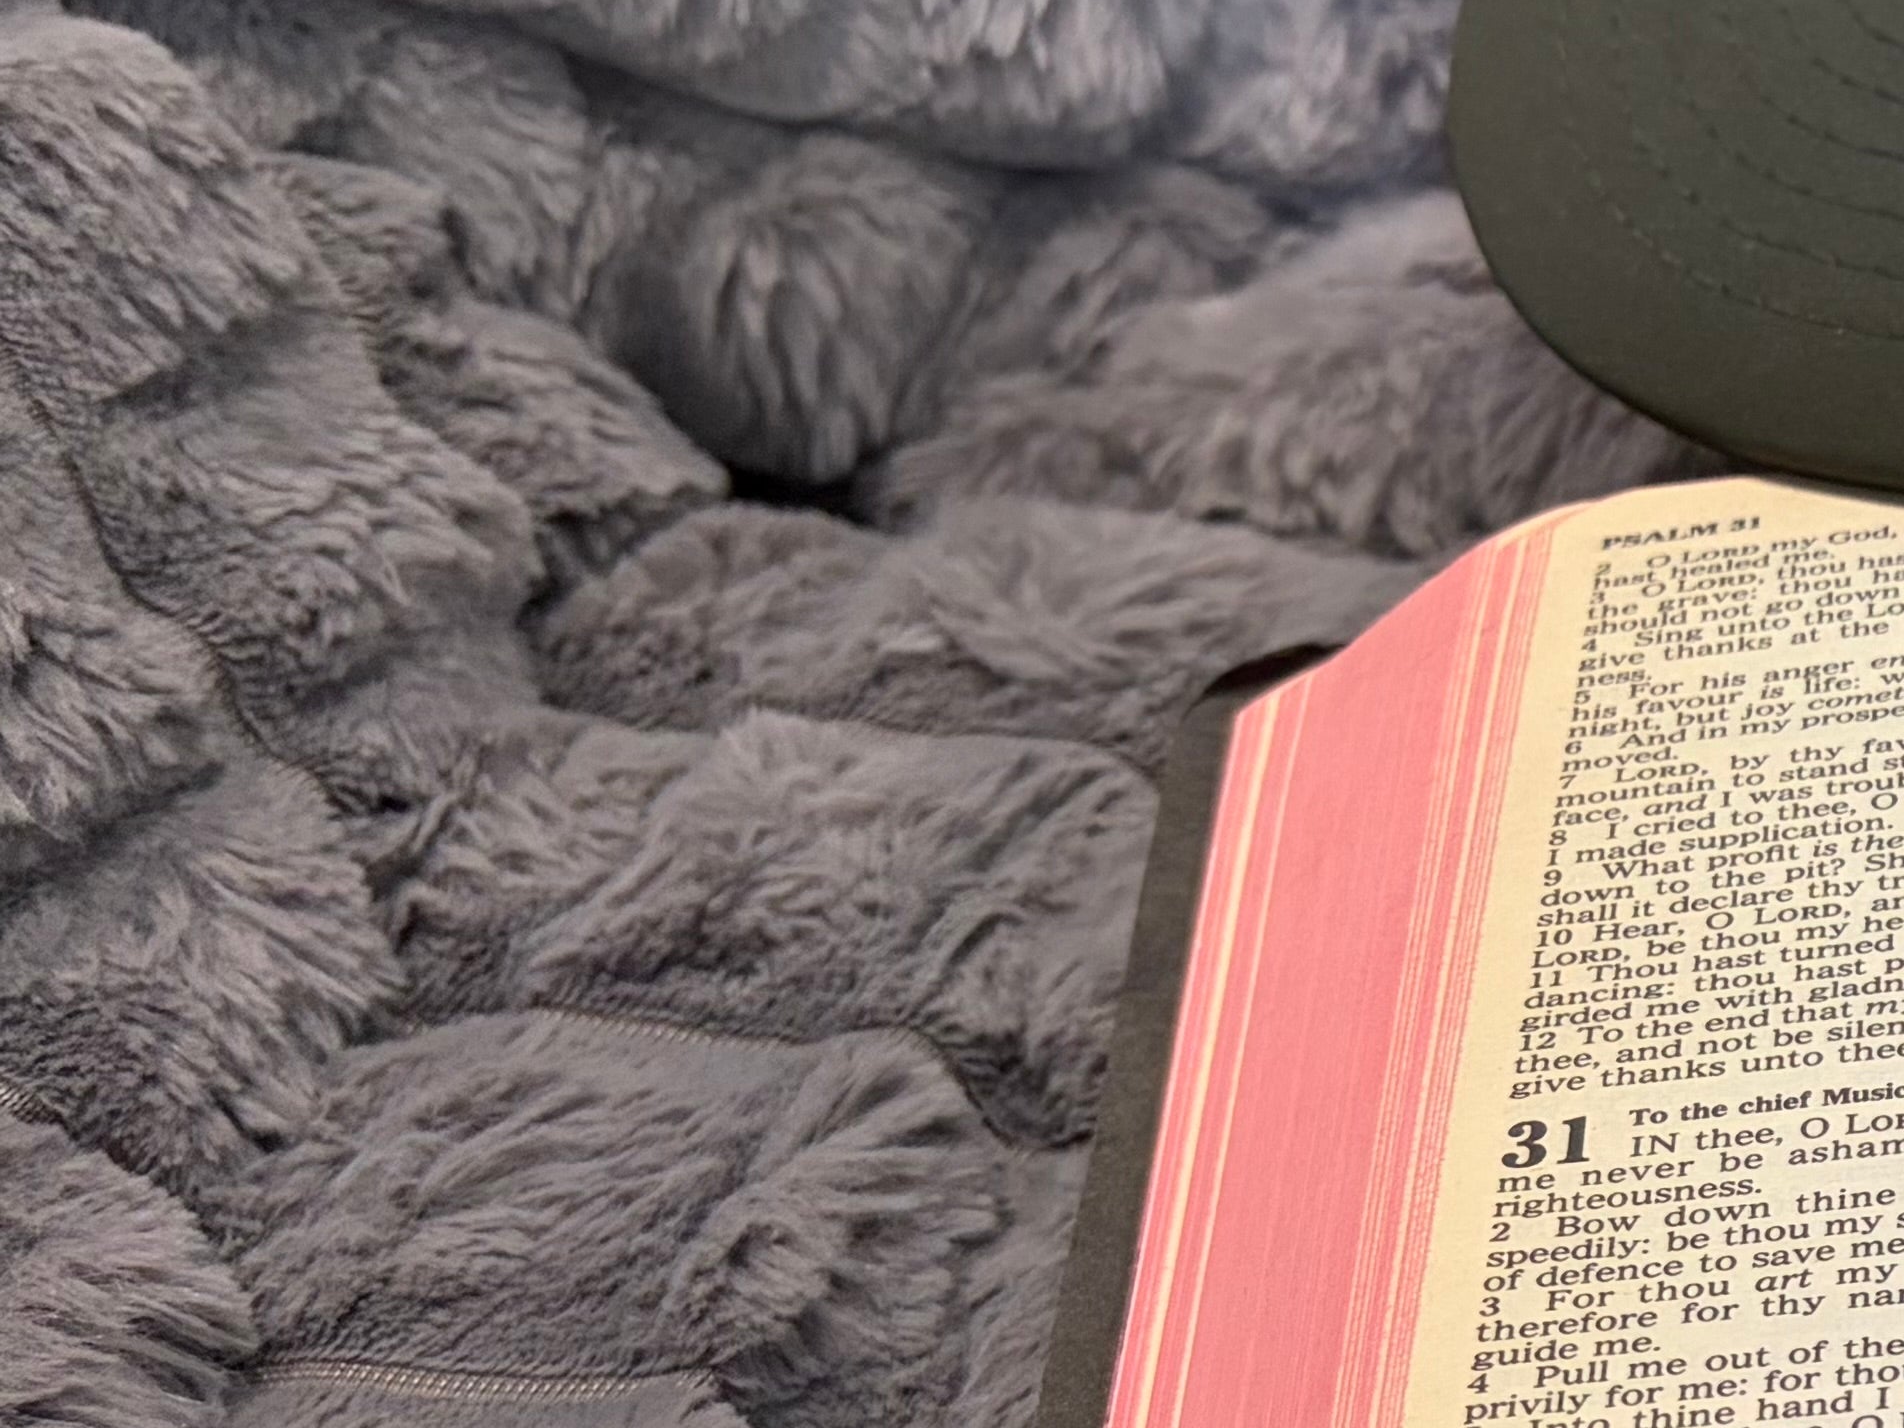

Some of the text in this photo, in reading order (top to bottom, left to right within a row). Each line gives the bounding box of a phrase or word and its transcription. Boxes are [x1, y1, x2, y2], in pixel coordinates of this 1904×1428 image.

[1627, 1106, 1669, 1127] To
[1679, 1101, 1728, 1122] the
[1737, 1089, 1813, 1115] chief
[1501, 1115, 1590, 1168] 31
[1628, 1131, 1679, 1158] IN
[1694, 1126, 1783, 1151] thee,
[1799, 1116, 1830, 1140] O
[1465, 1372, 1489, 1394] 4
[1532, 1358, 1609, 1389] Pull
[1626, 1357, 1687, 1380] me
[1704, 1346, 1770, 1372] out
[1787, 1338, 1829, 1365] of
